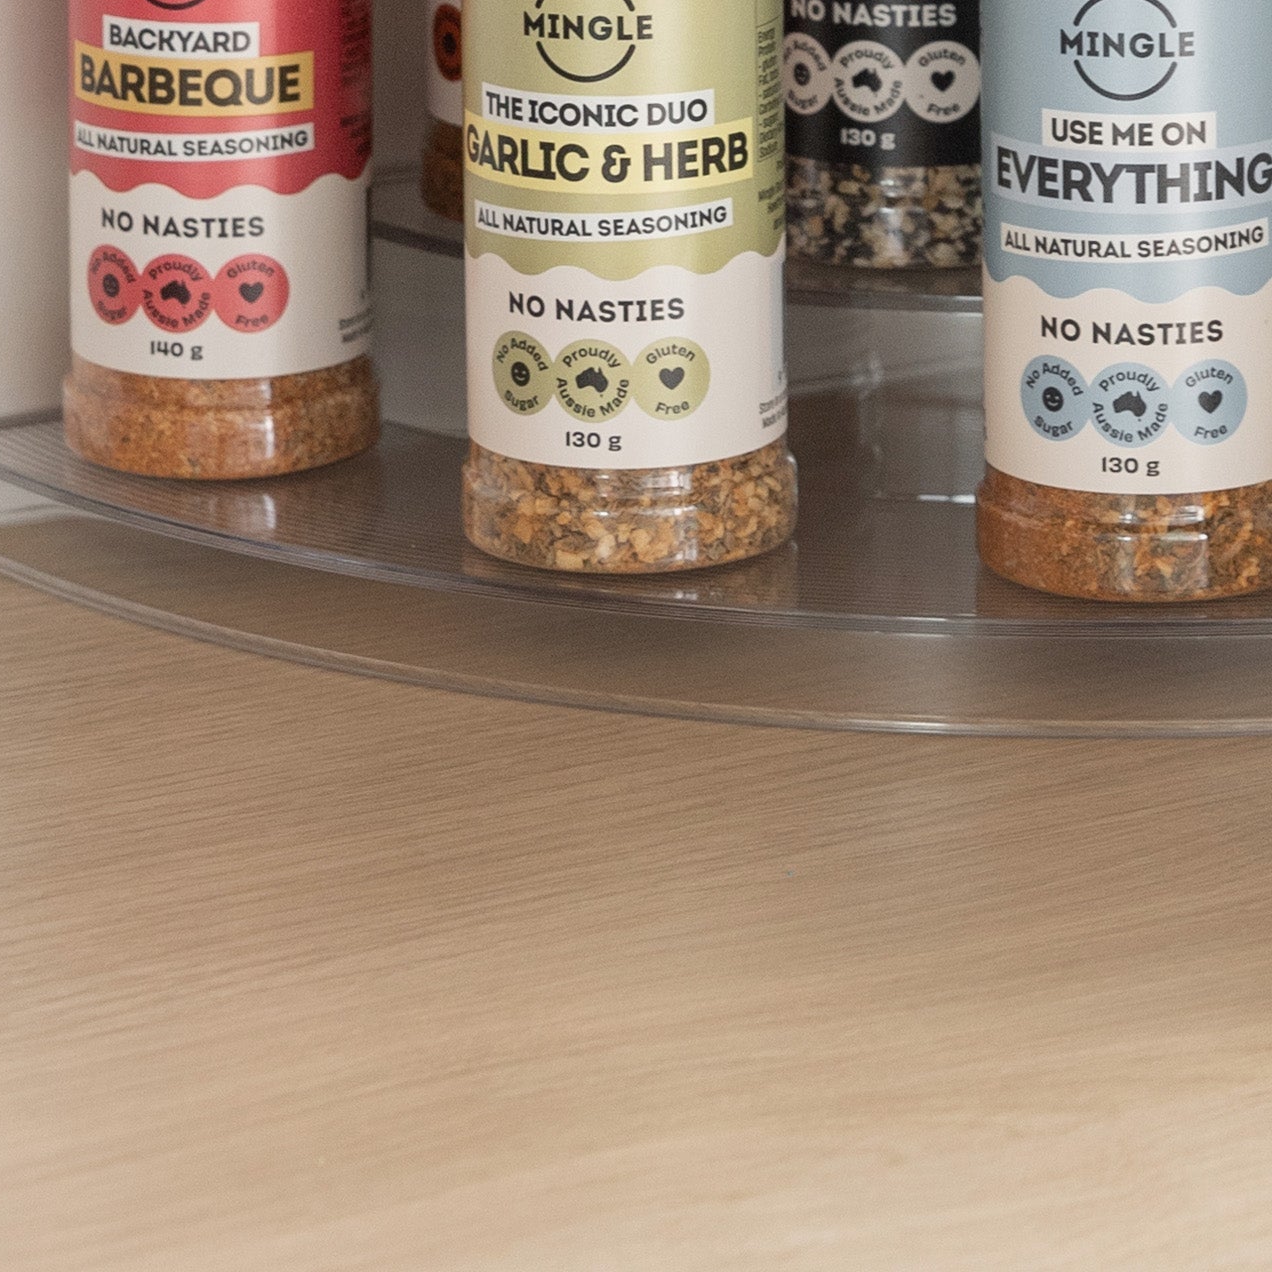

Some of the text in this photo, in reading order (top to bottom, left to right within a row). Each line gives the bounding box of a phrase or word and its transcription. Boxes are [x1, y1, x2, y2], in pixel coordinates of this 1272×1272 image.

[523, 11, 653, 41] MINGLE
[832, 3, 957, 28] NASTIES
[109, 23, 251, 53] BACKYARD
[1060, 29, 1195, 58] MINGLE
[80, 53, 301, 107] BARBEQUE
[486, 91, 707, 128] THE ICONIC DUO
[927, 103, 961, 116] Free
[97, 133, 178, 156] NATURAL
[183, 129, 309, 156] SEASONING
[840, 128, 896, 151] 130 g
[1051, 117, 1206, 147] USE ME ON
[466, 123, 748, 183] GARLIC & HERB
[101, 208, 265, 238] NO NASTIES
[478, 205, 727, 237] ALL NATURAL SEASONING
[1004, 230, 1031, 251] ALL
[1035, 235, 1132, 258] NATURAL
[1137, 225, 1264, 257] SEASONING
[226, 259, 275, 278] Gluten
[509, 291, 685, 323] NO NASTIES
[235, 314, 269, 328] Free
[1041, 315, 1223, 346] NO NASTIES
[150, 340, 203, 361] 140 g
[496, 337, 548, 372] No Added
[563, 347, 621, 369] Proudly
[646, 343, 696, 364] Gluten
[1026, 362, 1084, 397] No Added
[1099, 371, 1160, 394] Proudly
[1185, 367, 1234, 388] Gluten
[504, 389, 539, 412] Sugar
[556, 377, 630, 418] Aussie Made
[655, 399, 690, 416] Free
[1034, 414, 1074, 438] Sugar
[1092, 401, 1169, 443] Aussie Made
[1194, 424, 1228, 440] Free
[565, 431, 622, 452] 130 g
[1101, 456, 1160, 477] 130 g
